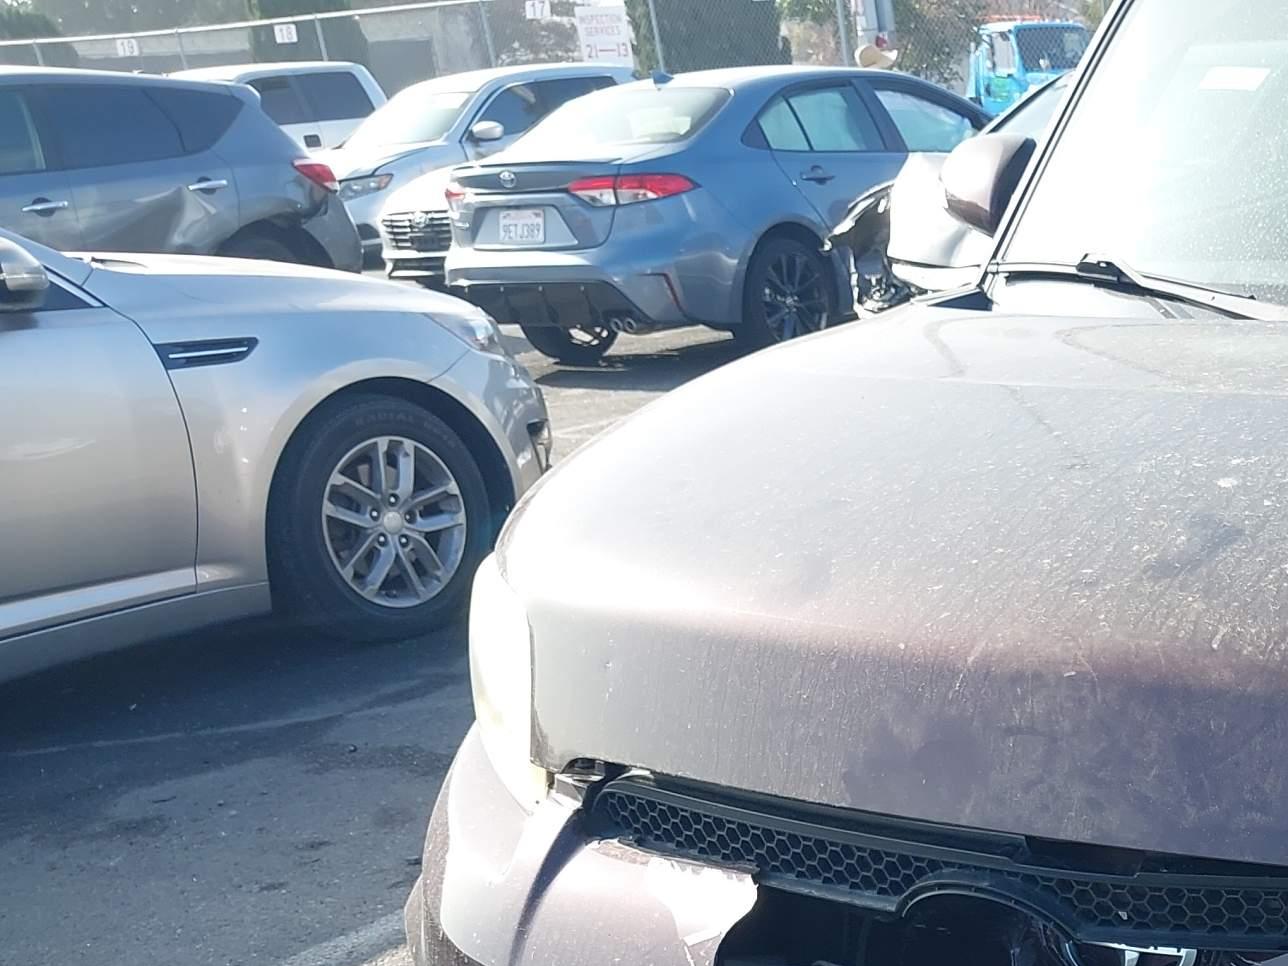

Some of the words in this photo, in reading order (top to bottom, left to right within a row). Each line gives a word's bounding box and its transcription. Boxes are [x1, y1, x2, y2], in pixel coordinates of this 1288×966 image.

[531, 1, 546, 16] 17
[278, 26, 294, 40] 18
[584, 26, 621, 36] SERVICES
[120, 40, 136, 55] 19
